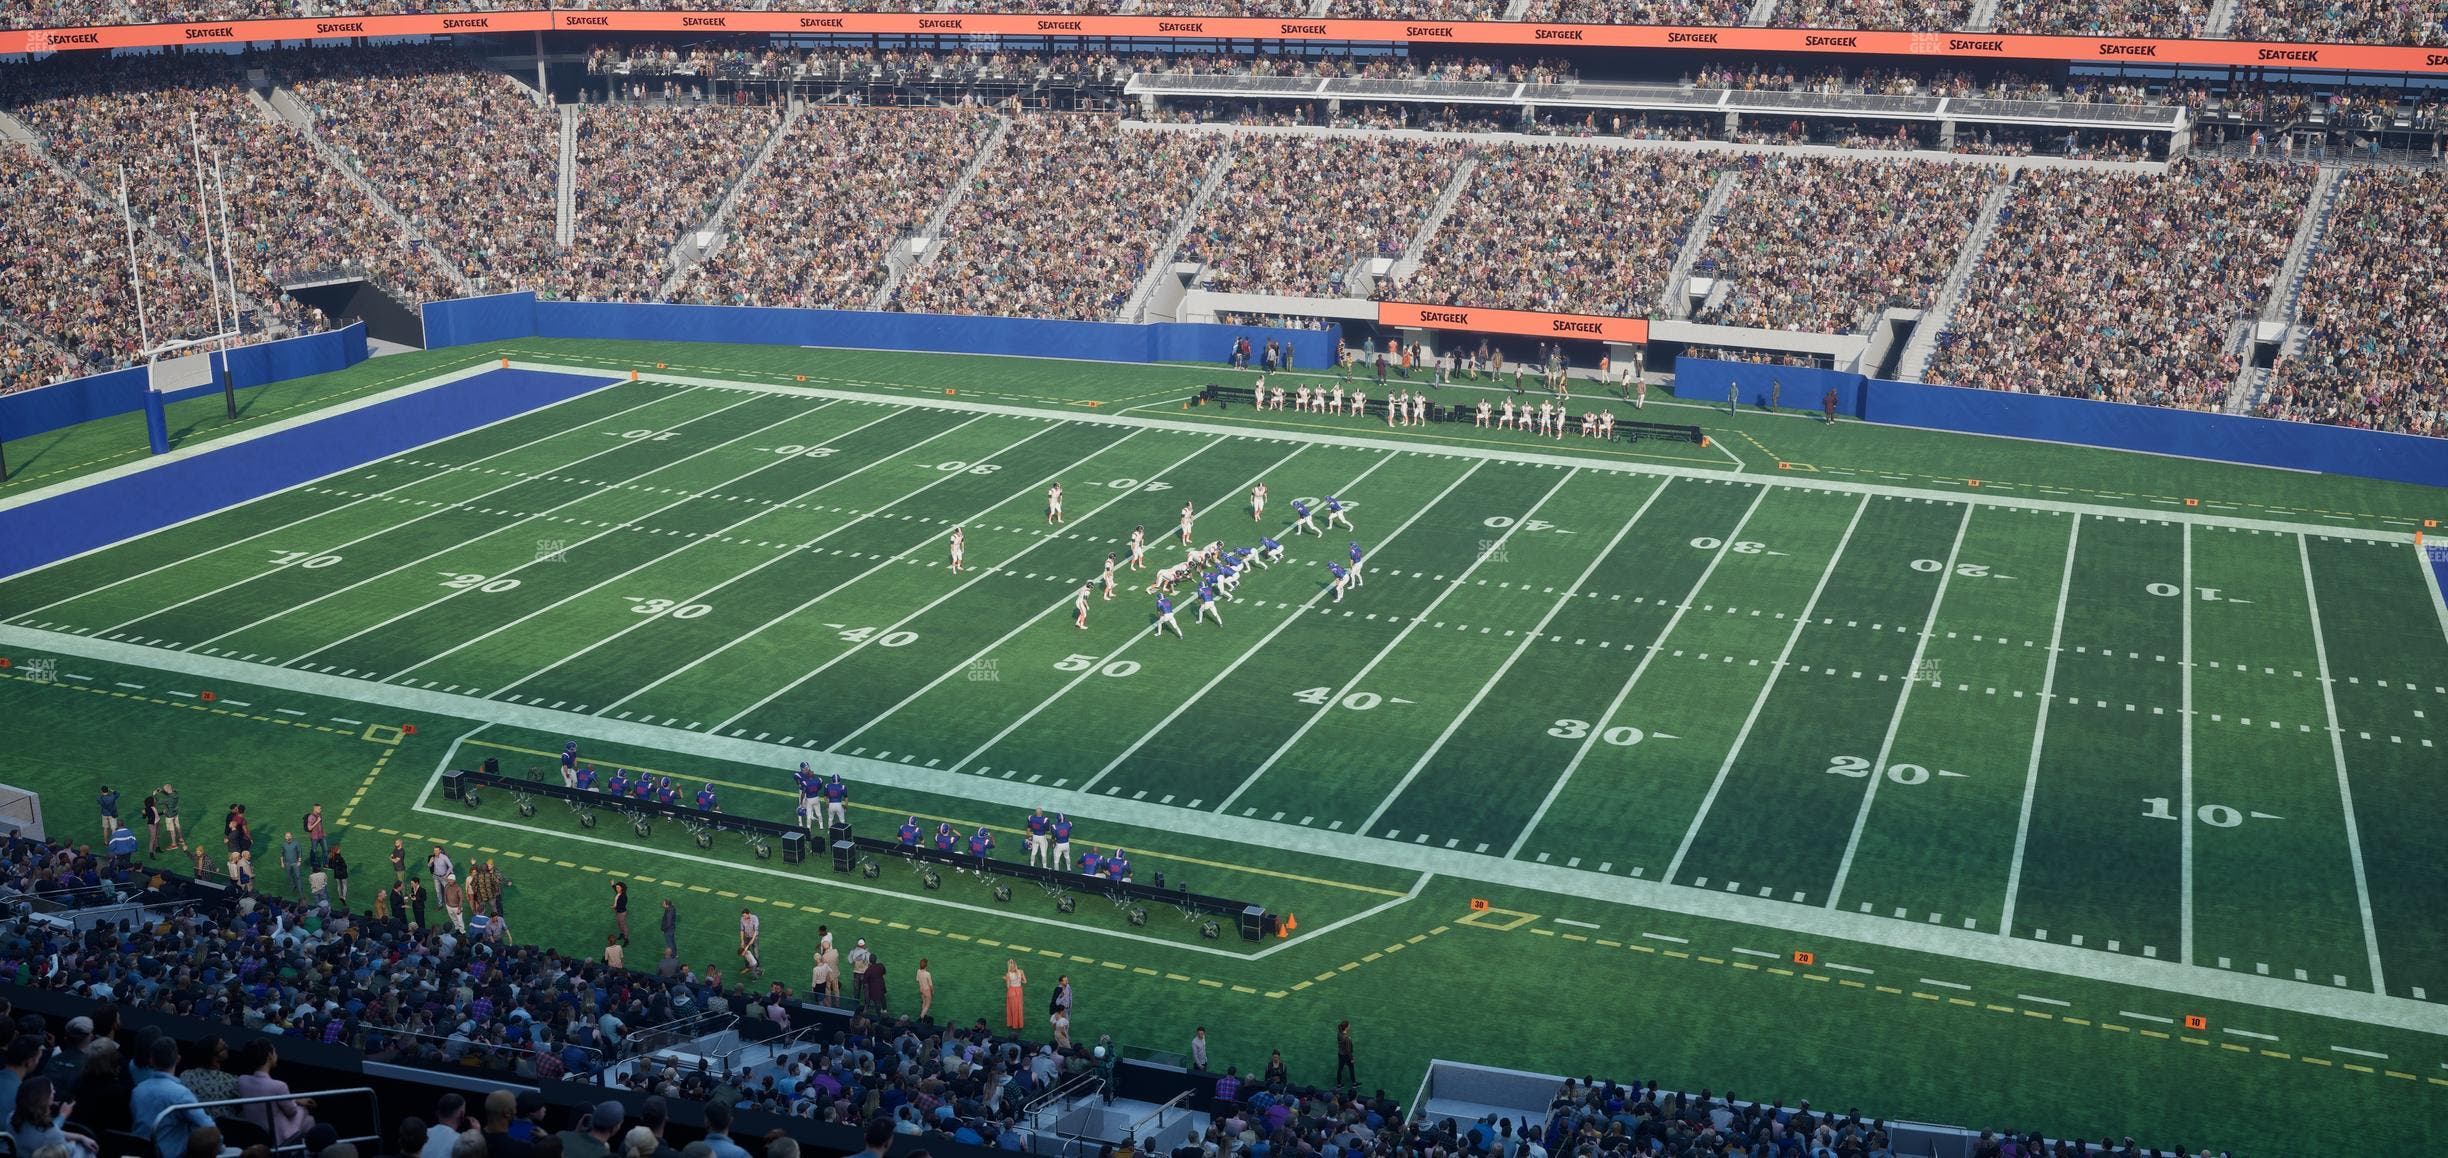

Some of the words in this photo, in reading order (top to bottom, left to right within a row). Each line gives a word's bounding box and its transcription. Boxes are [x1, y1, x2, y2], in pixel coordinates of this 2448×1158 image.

[442, 18, 489, 29] SEATGEEK
[566, 16, 609, 26] SEATGEEK
[682, 17, 726, 27] SEATGEEK
[800, 17, 843, 28] SEATGEEK
[918, 19, 962, 29] SEATGEEK
[1037, 20, 1082, 31] SEATGEEK
[1158, 22, 1203, 33] SEATGEEK
[185, 26, 234, 39] SEATGEEK
[316, 22, 364, 34] SEATGEEK
[1281, 24, 1327, 35] SEATGEEK
[1406, 26, 1453, 38] SEATGEEK
[47, 32, 99, 46] SEATGEEK
[1535, 29, 1583, 41] SEATGEEK
[1667, 32, 1718, 44] SEATGEEK
[1805, 35, 1857, 48] SEATGEEK
[1949, 39, 2004, 52] SEATGEEK
[2099, 43, 2157, 57] SEATGEEK
[2258, 48, 2319, 63] SEATGEEK
[1420, 310, 1469, 325] SEATGEEK
[1552, 319, 1603, 335] SEATGEEK
[621, 429, 682, 441] 10
[774, 445, 840, 458] 20
[936, 461, 1002, 475] 30
[1108, 479, 1174, 492] 40
[1484, 517, 1555, 532] 40
[1690, 537, 1766, 554] 30
[268, 551, 343, 569] 10
[1910, 560, 1991, 578] 20
[439, 574, 521, 592] 20
[2146, 583, 2223, 601] 10
[631, 599, 712, 618] 30
[838, 627, 918, 647] 40
[1053, 654, 1142, 677] 50
[1293, 687, 1382, 710] 40
[1547, 719, 1643, 745] 30
[1826, 756, 1929, 784] 20
[2142, 798, 2242, 827] 10
[1474, 900, 1484, 909] 30
[1798, 953, 1809, 962] 20
[2190, 1018, 2200, 1027] 10
